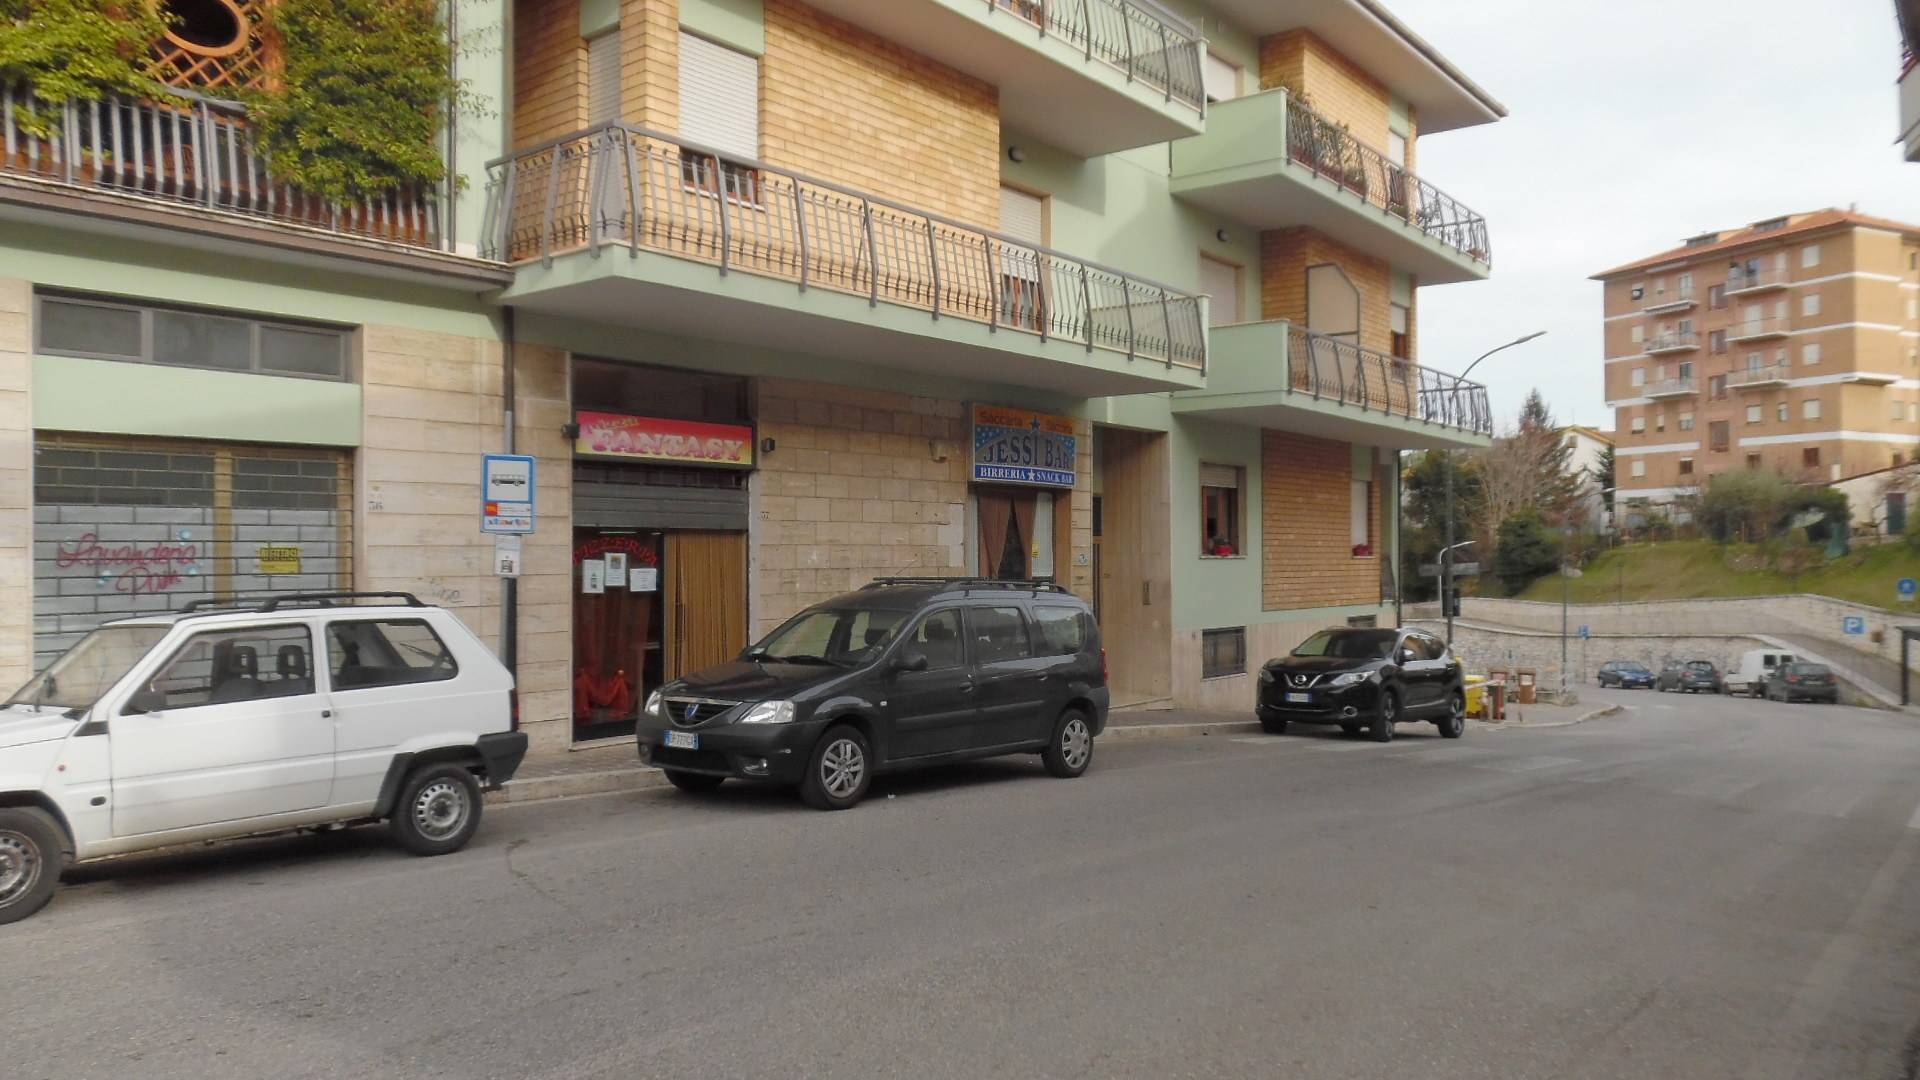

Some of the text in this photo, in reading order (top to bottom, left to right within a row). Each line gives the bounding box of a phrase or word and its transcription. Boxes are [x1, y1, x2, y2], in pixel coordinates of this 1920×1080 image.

[591, 428, 744, 461] FANTASY
[984, 435, 1070, 469] JESSI BAR
[980, 467, 1026, 480] BIRRERIA
[1036, 471, 1073, 484] SNACK BAR
